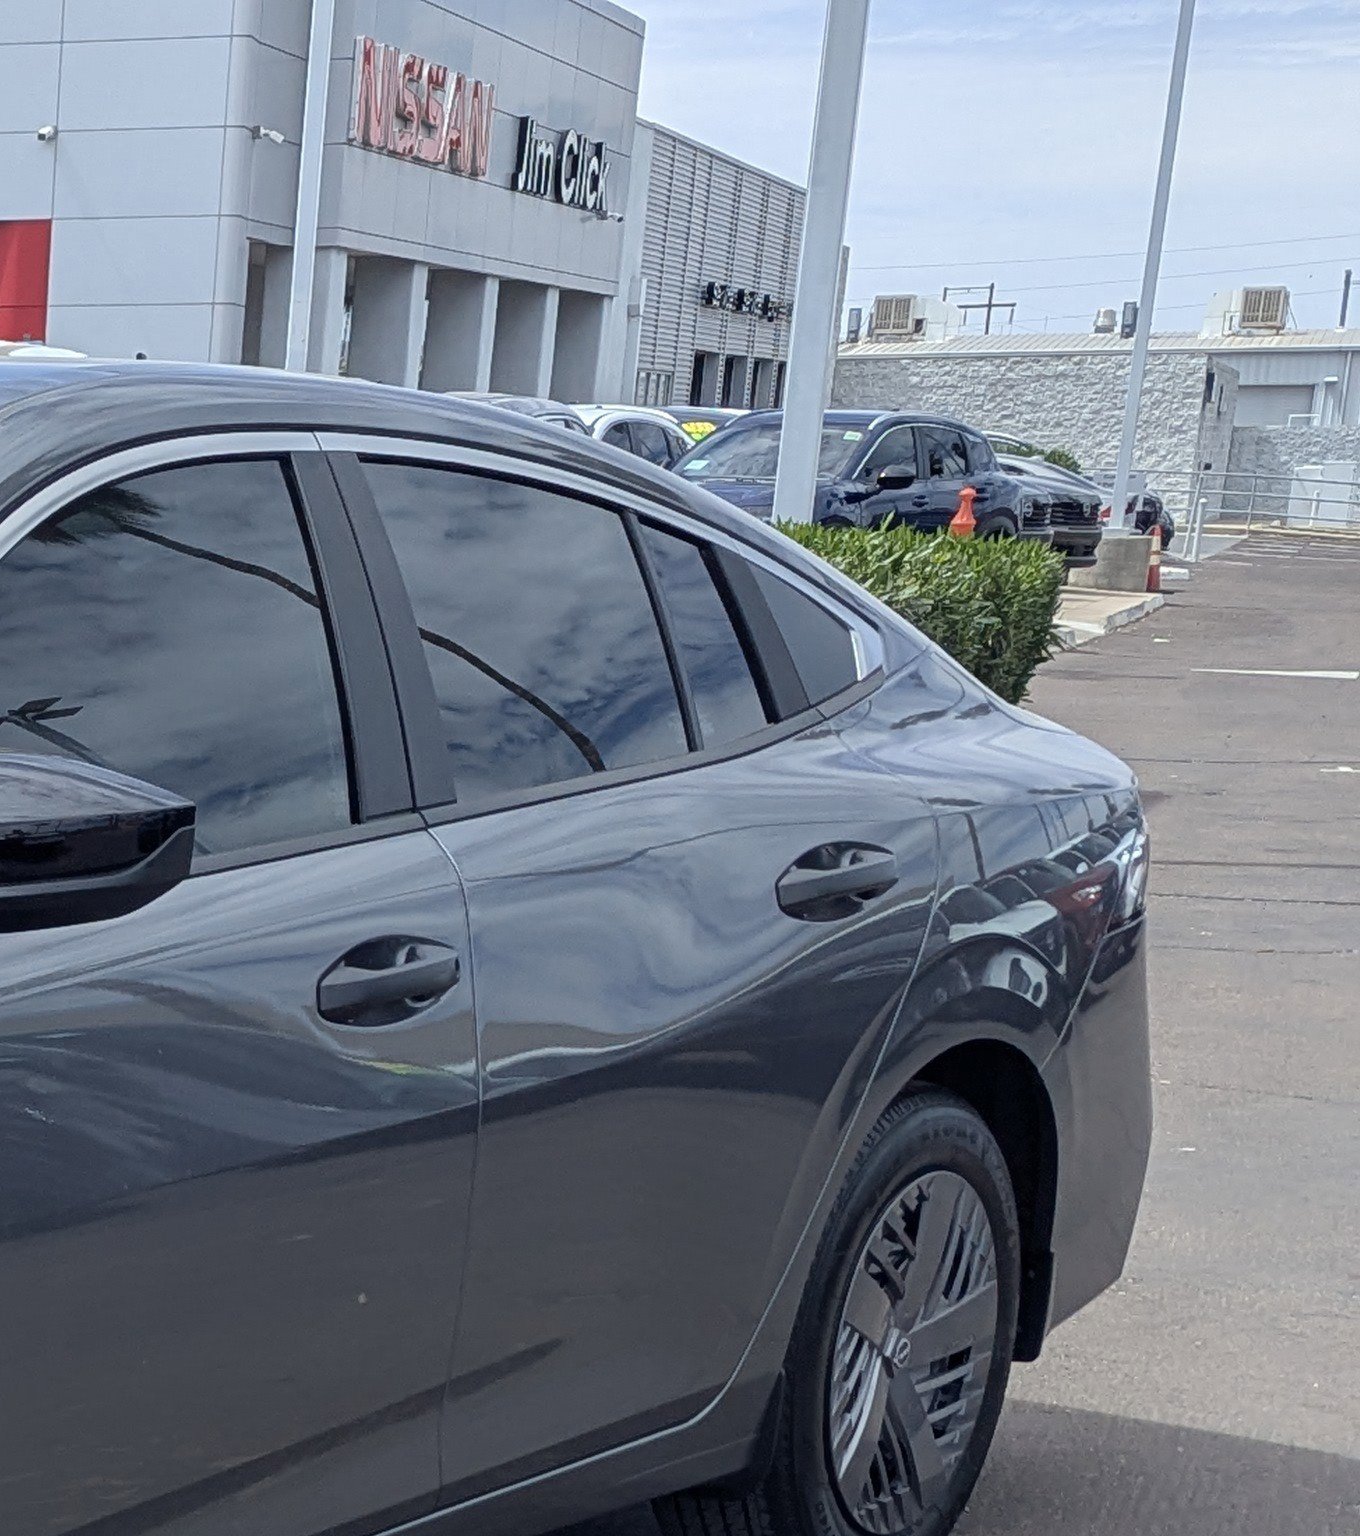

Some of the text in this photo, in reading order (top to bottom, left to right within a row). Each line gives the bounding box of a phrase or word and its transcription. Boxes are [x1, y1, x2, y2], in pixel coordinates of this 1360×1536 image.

[352, 35, 495, 179] NISSAN
[511, 115, 612, 213] Jim Click
